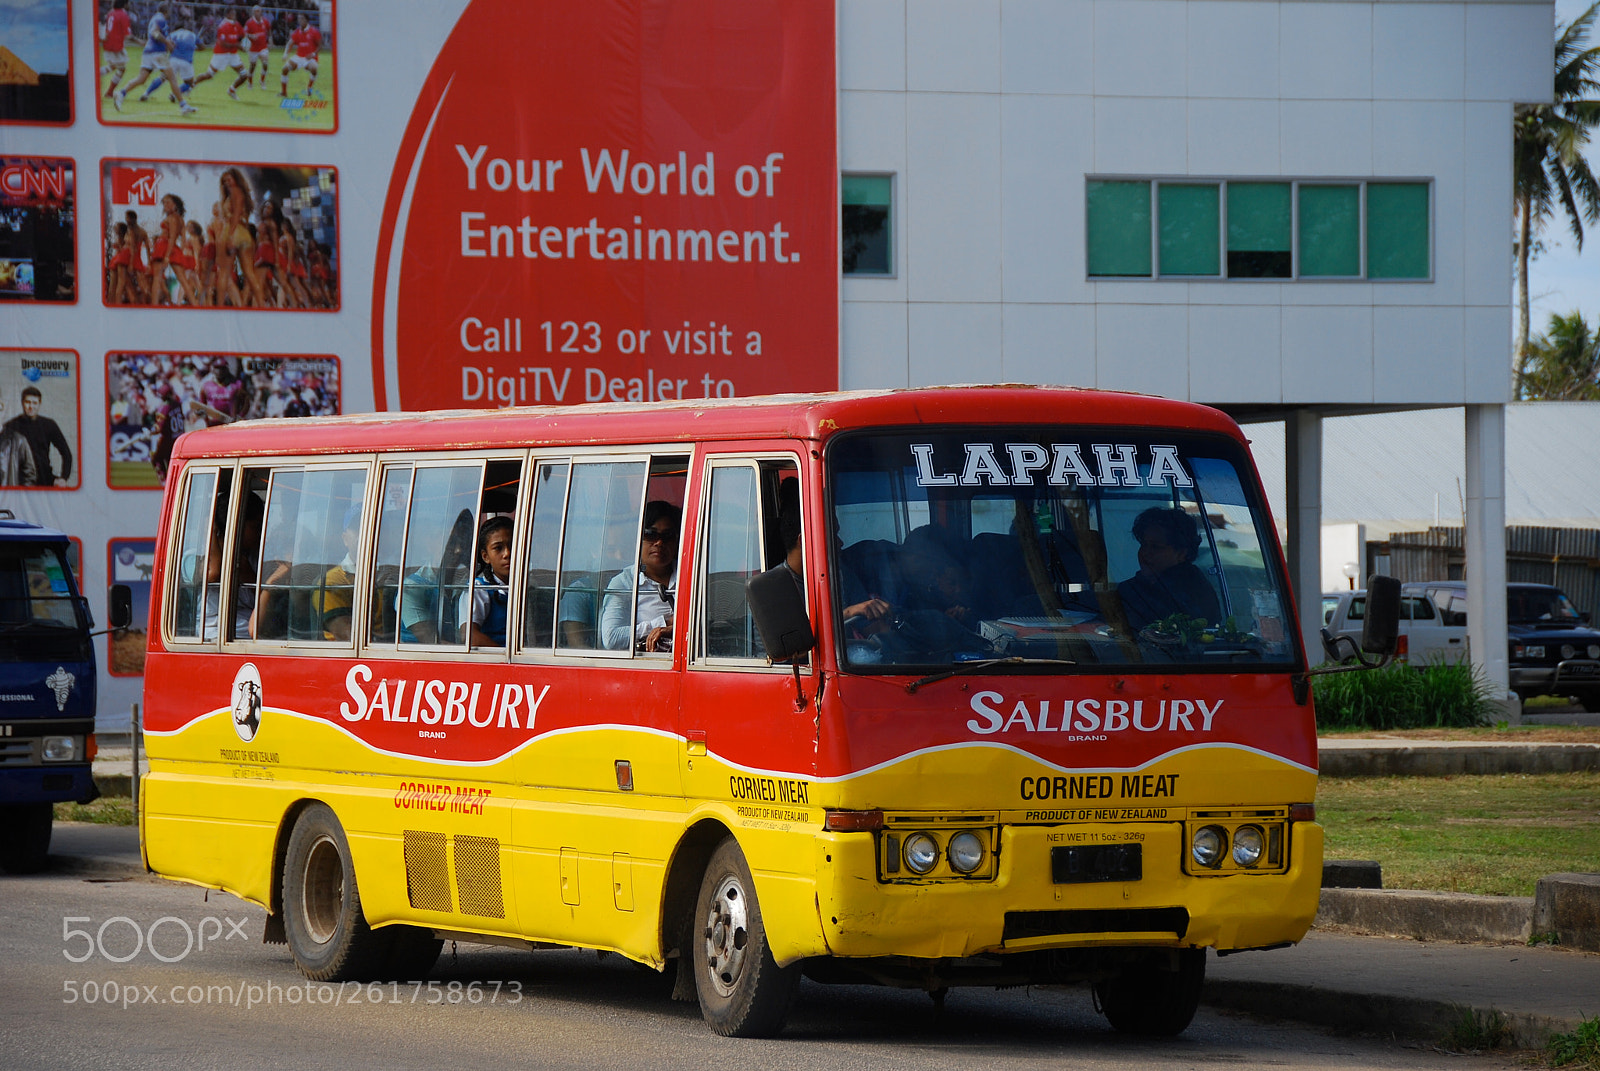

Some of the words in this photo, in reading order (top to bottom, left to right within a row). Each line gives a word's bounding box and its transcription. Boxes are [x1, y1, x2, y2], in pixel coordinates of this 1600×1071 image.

[1, 164, 64, 198] CNN
[111, 166, 163, 206] MTV
[455, 144, 563, 192] Your
[580, 147, 716, 196] World
[735, 152, 784, 198] of
[460, 211, 801, 263] Entertainment.
[460, 316, 522, 353] Call
[540, 320, 602, 354] 123
[617, 329, 651, 355] or
[663, 320, 733, 356] visit
[745, 330, 762, 356] a
[21, 358, 69, 371] Discovery
[461, 366, 572, 408] DigiTV
[585, 367, 688, 402] Dealer
[701, 372, 735, 399] to
[910, 443, 1195, 488] LAPAHA
[339, 663, 551, 730] SALISBURY
[966, 690, 1224, 735] SALISBURY
[418, 730, 446, 739] BRAND
[394, 781, 451, 812] CORNED
[450, 786, 492, 816] MEAT
[730, 775, 776, 802] CORNED
[778, 780, 809, 804] MEAT
[1020, 775, 1114, 800] CORNED
[1120, 774, 1180, 799] MEAT
[738, 806, 762, 818] PRODUCT
[763, 808, 770, 818] OF
[771, 809, 783, 820] NEW
[784, 810, 809, 822] ZEALAND
[1025, 810, 1077, 821] PRODUCT
[1078, 810, 1092, 820] OF
[1094, 809, 1120, 820] NEW
[1120, 808, 1168, 819] ZEALAND
[1046, 833, 1066, 842] NET
[1067, 833, 1087, 841] WET
[1123, 832, 1145, 841] 326g
